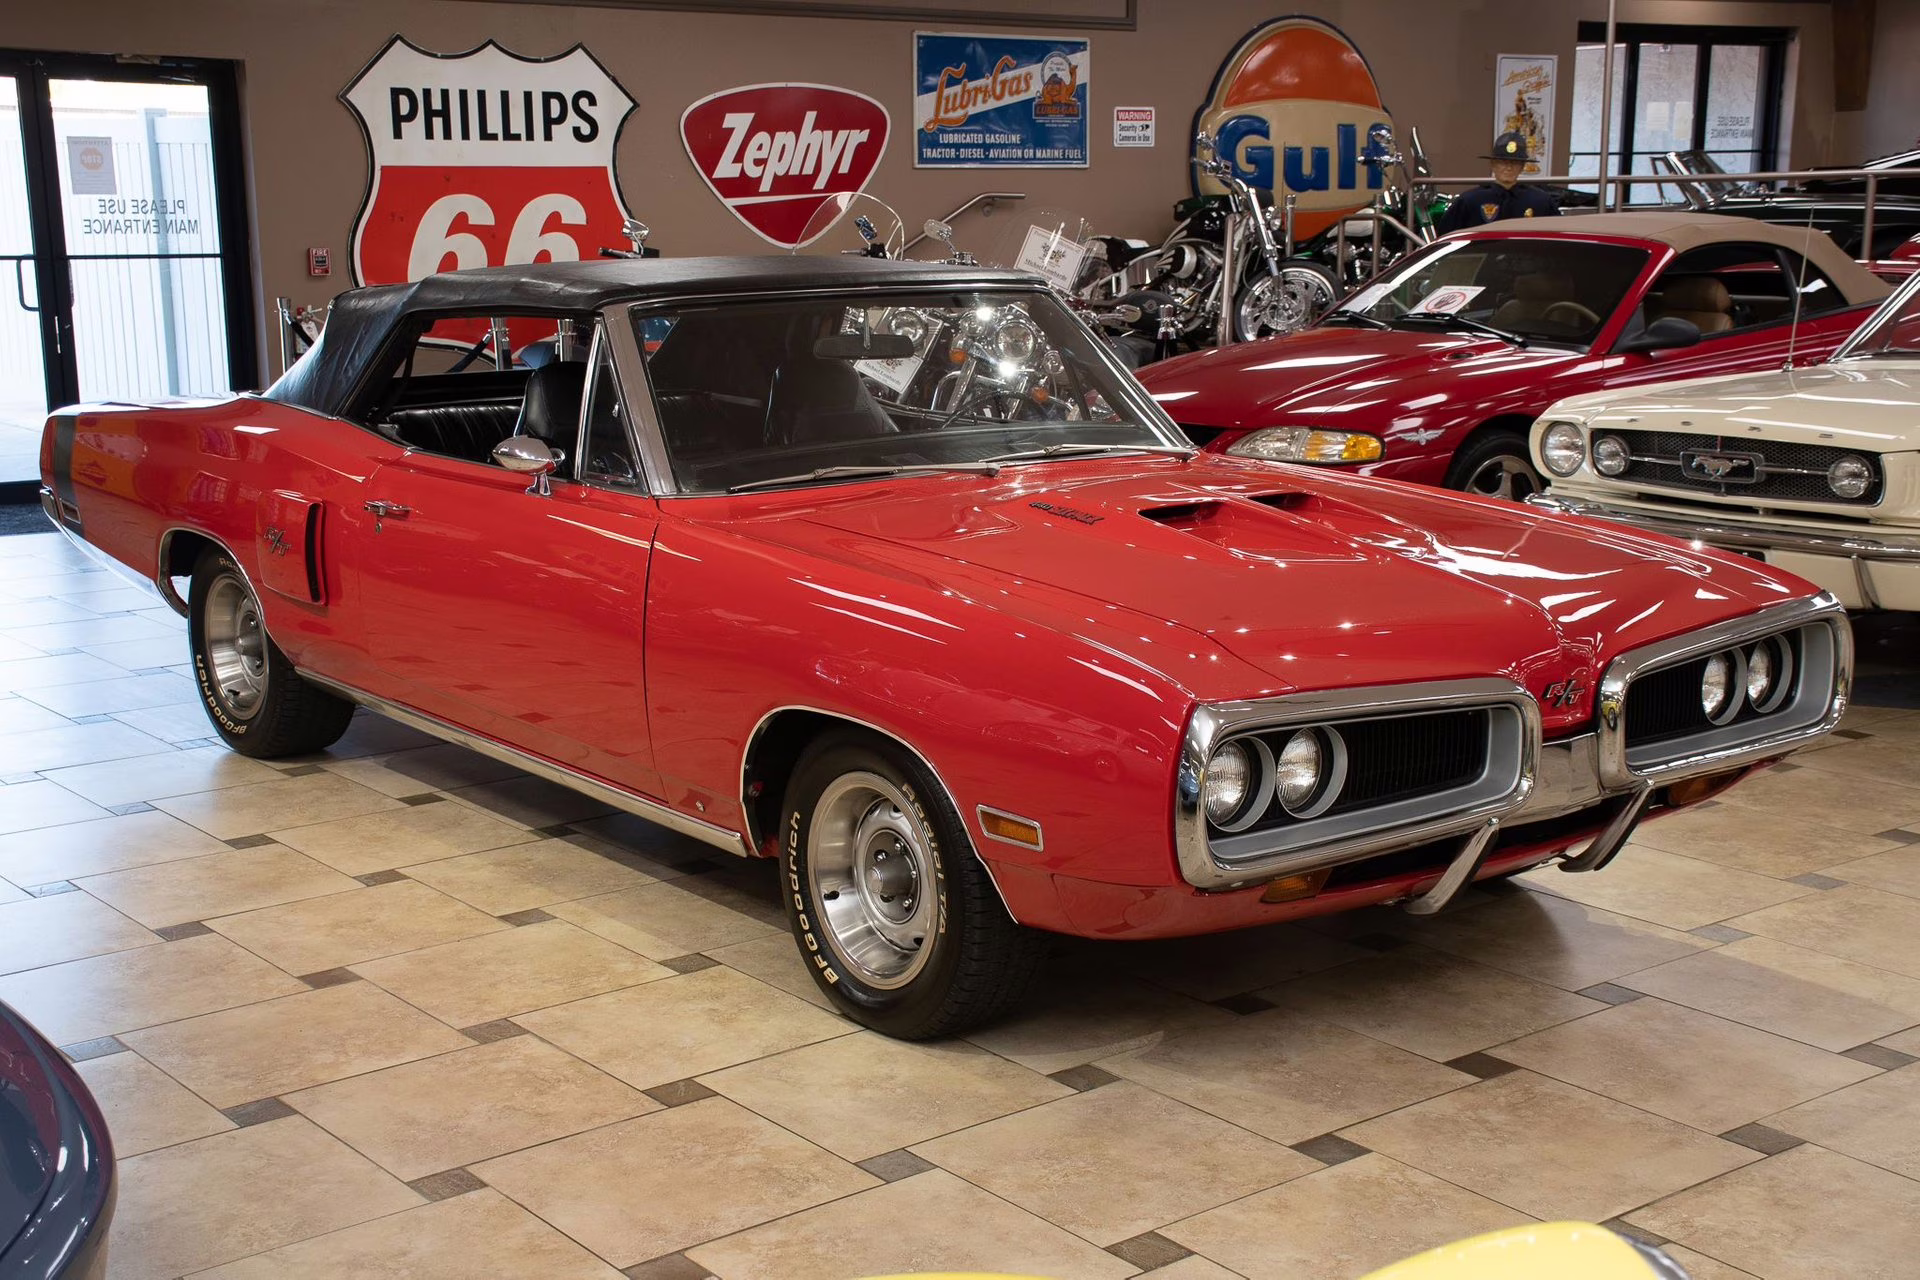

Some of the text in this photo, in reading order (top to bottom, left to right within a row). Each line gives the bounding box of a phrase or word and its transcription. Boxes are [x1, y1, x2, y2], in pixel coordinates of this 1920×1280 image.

[390, 87, 599, 143] PHILLIPS
[712, 111, 870, 192] Zephyr
[923, 148, 1082, 159] TRACTOR DIESEL AVIATION OR MARINE FUEL
[939, 133, 1021, 144] LUBRICATED GASOLINE
[1118, 111, 1151, 120] WARNING
[1215, 114, 1392, 192] Gulf
[408, 193, 587, 283] 66
[195, 654, 248, 734] BFGoodrich
[1542, 679, 1585, 708] R/T
[902, 782, 948, 934] Radial T/A
[787, 810, 840, 985] BFGoodrich
